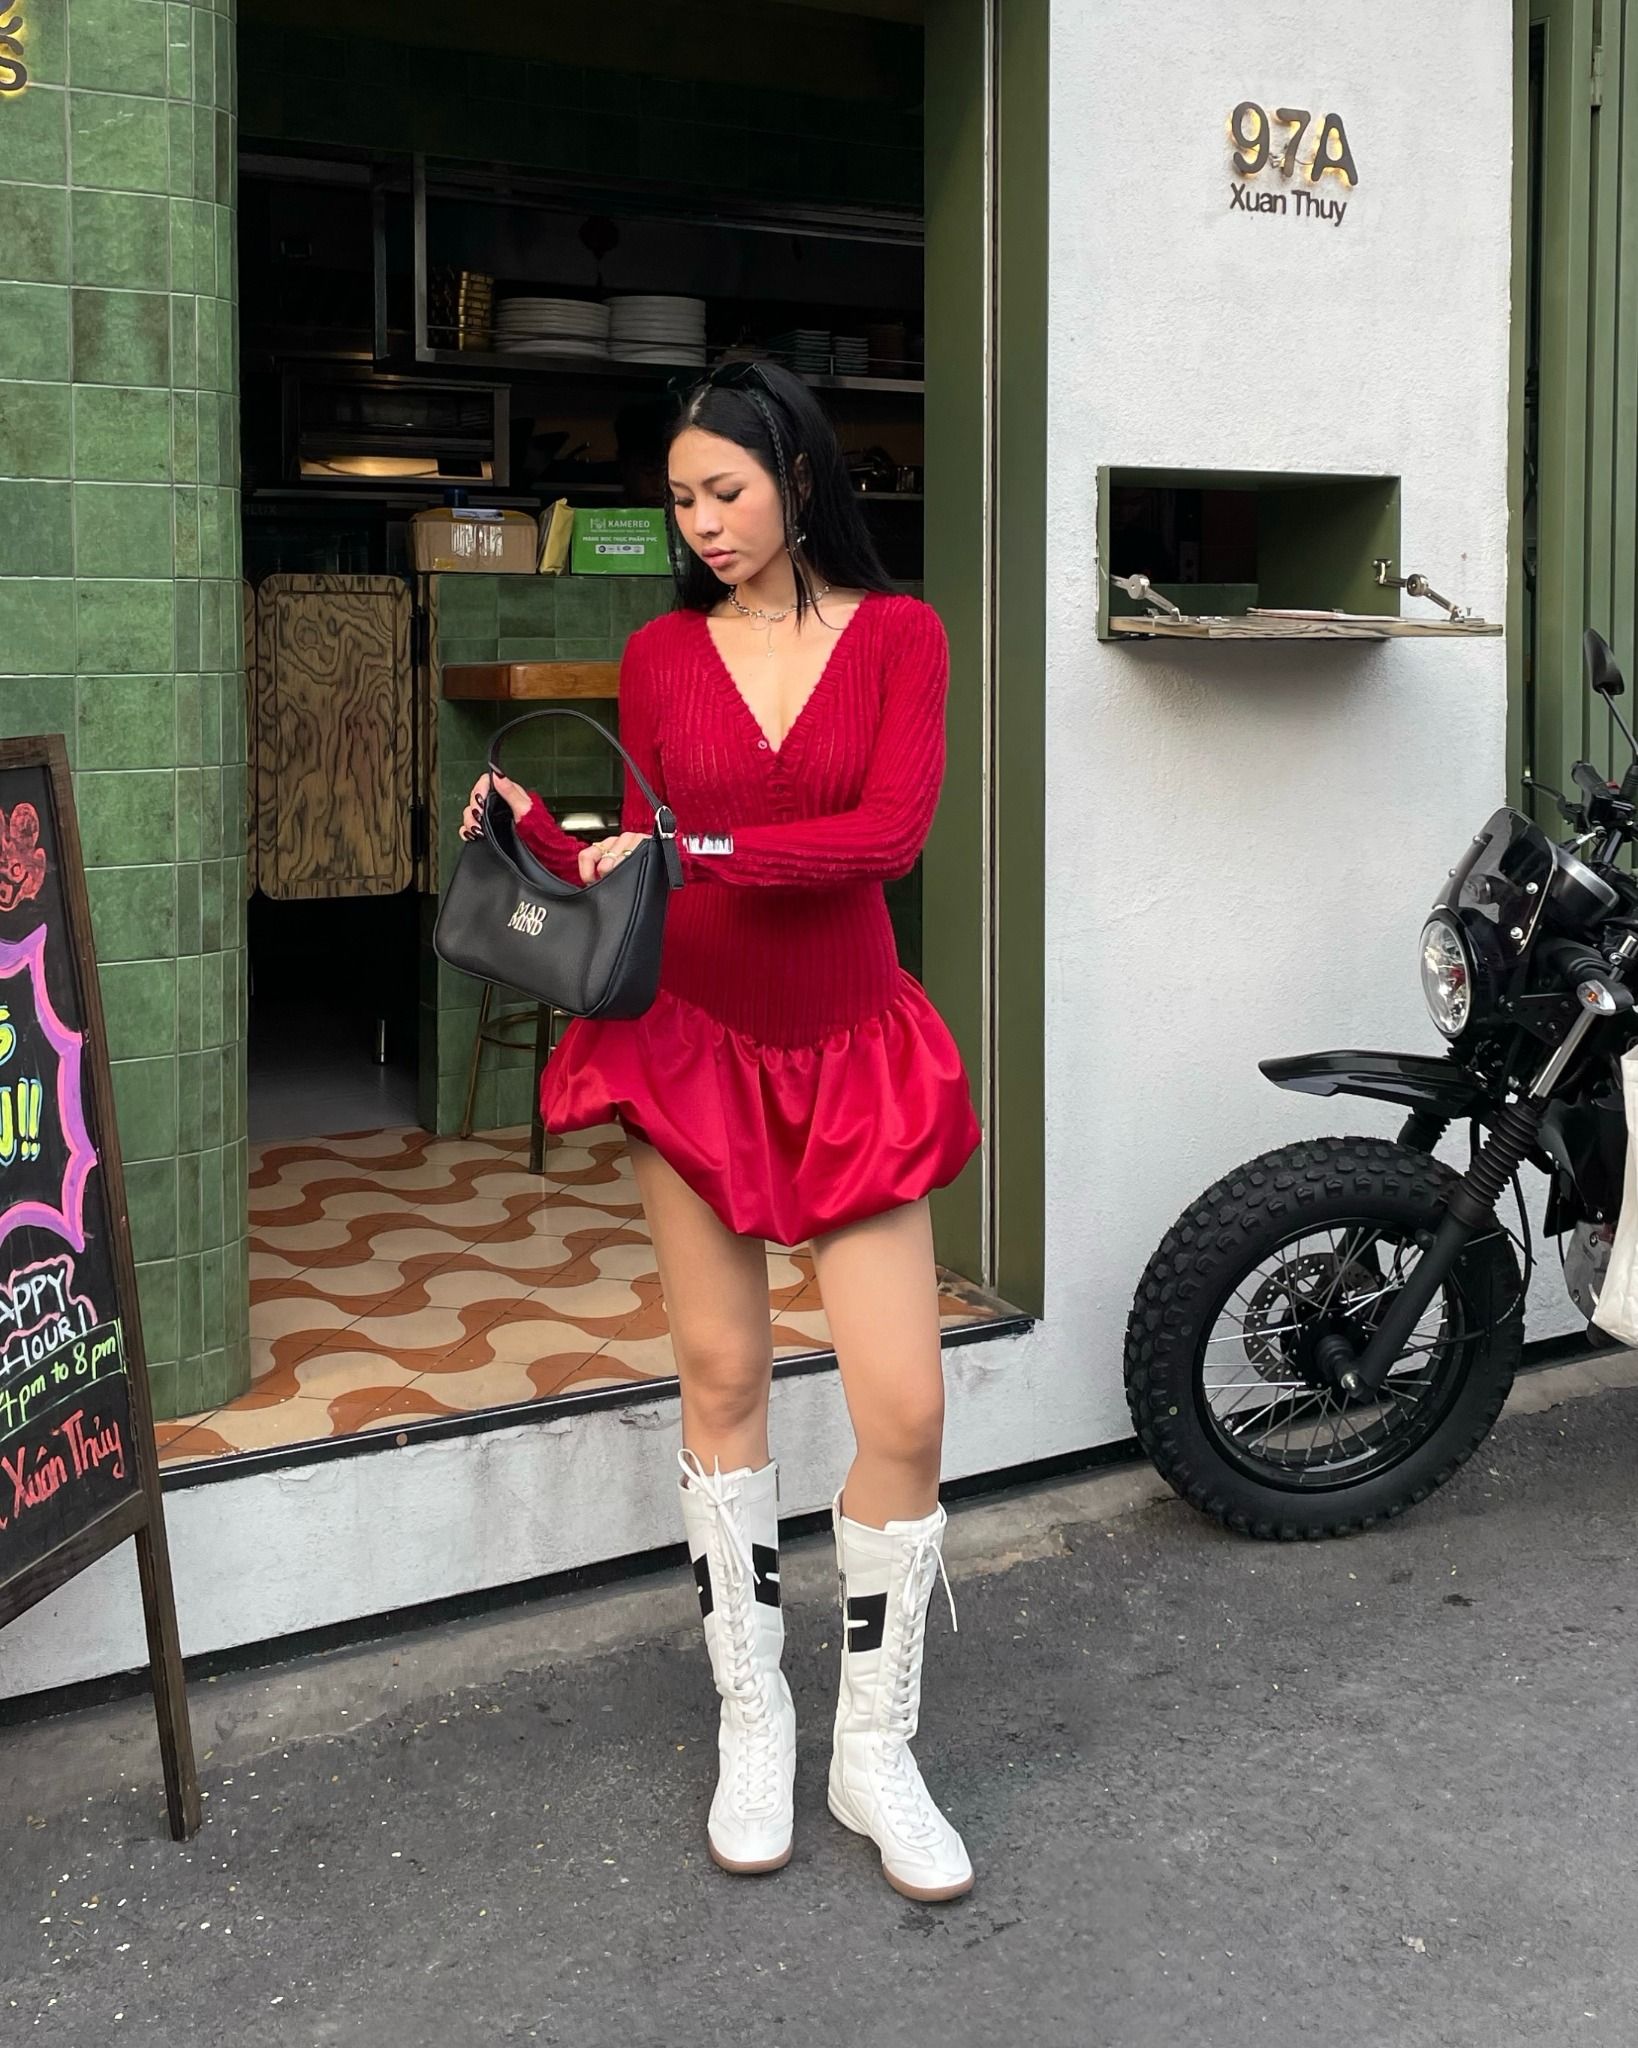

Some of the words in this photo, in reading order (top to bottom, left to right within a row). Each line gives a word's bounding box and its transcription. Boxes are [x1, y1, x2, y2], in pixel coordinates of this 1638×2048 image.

[1231, 101, 1359, 186] 97A
[1229, 182, 1287, 215] Xuan
[1291, 190, 1348, 228] Thuy
[607, 519, 650, 528] KAMEREO
[515, 901, 547, 921] MAD
[507, 913, 543, 936] MIND
[51, 1361, 69, 1384] to
